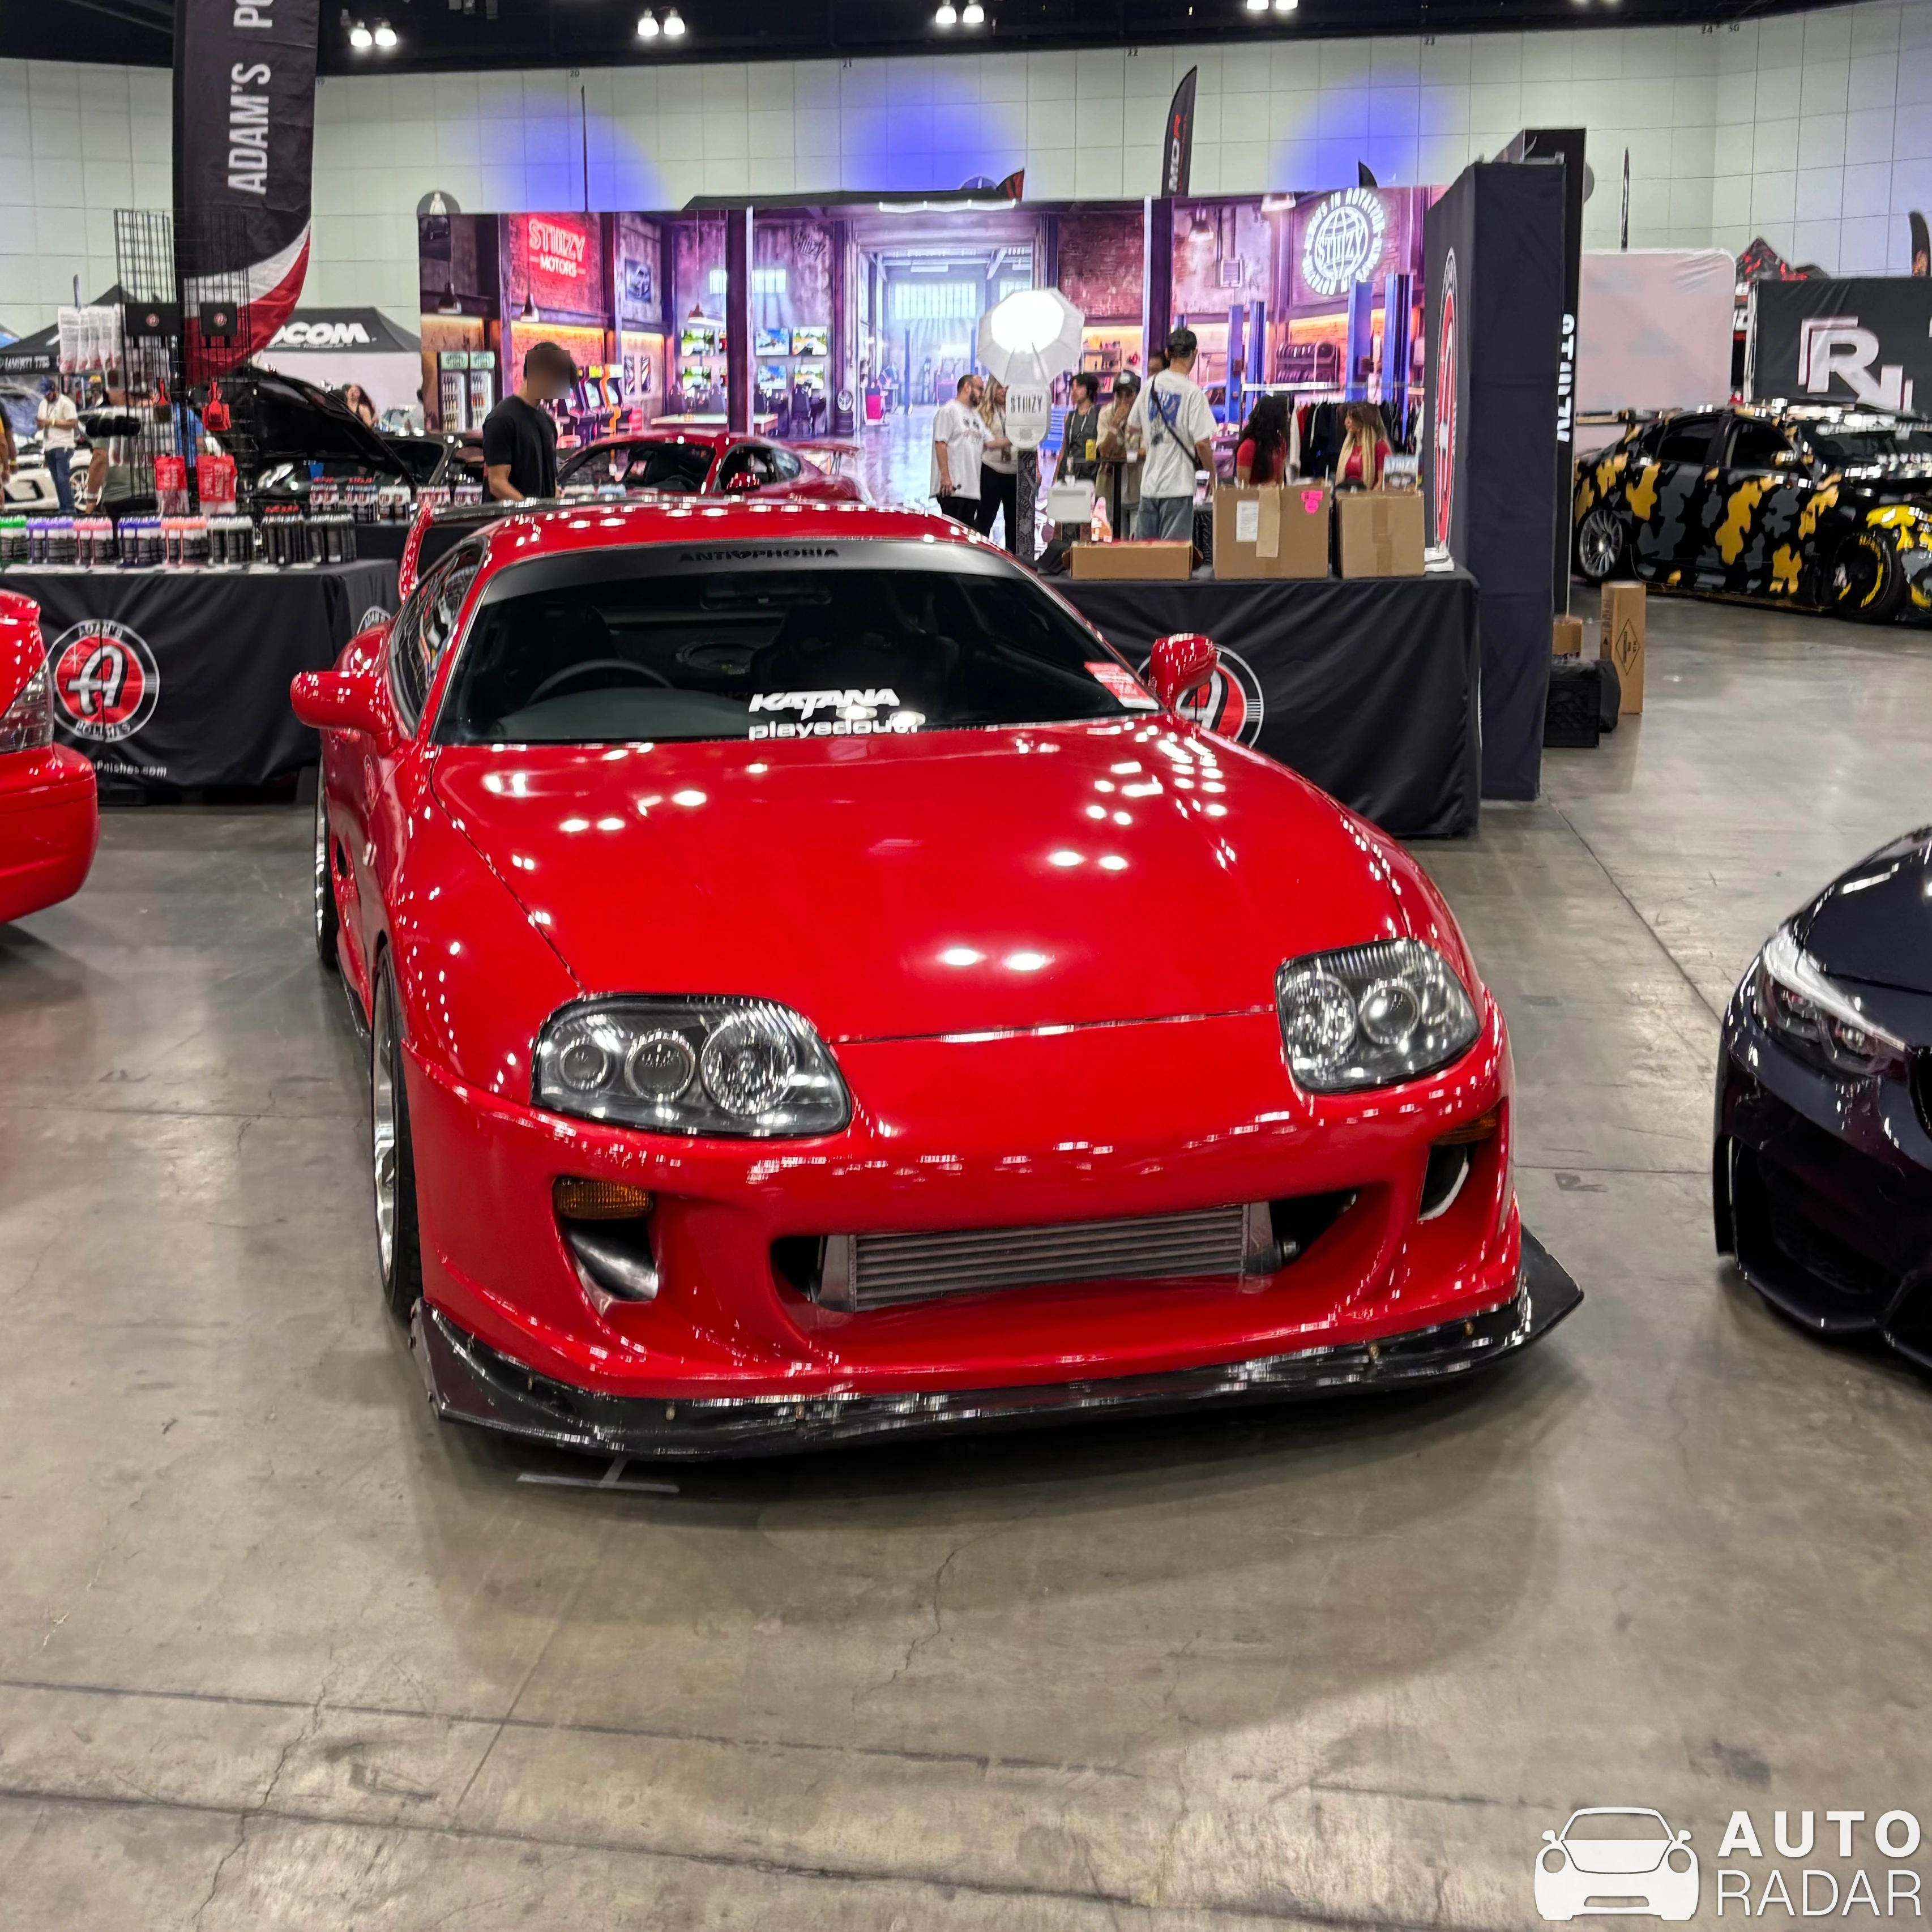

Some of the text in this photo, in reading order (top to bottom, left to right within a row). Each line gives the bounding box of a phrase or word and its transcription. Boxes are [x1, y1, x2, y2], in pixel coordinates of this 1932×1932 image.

[228, 0, 273, 195] ADAM'S P
[1330, 191, 1341, 210] IN
[540, 253, 577, 278] MOTORS
[749, 688, 900, 721] KATANA
